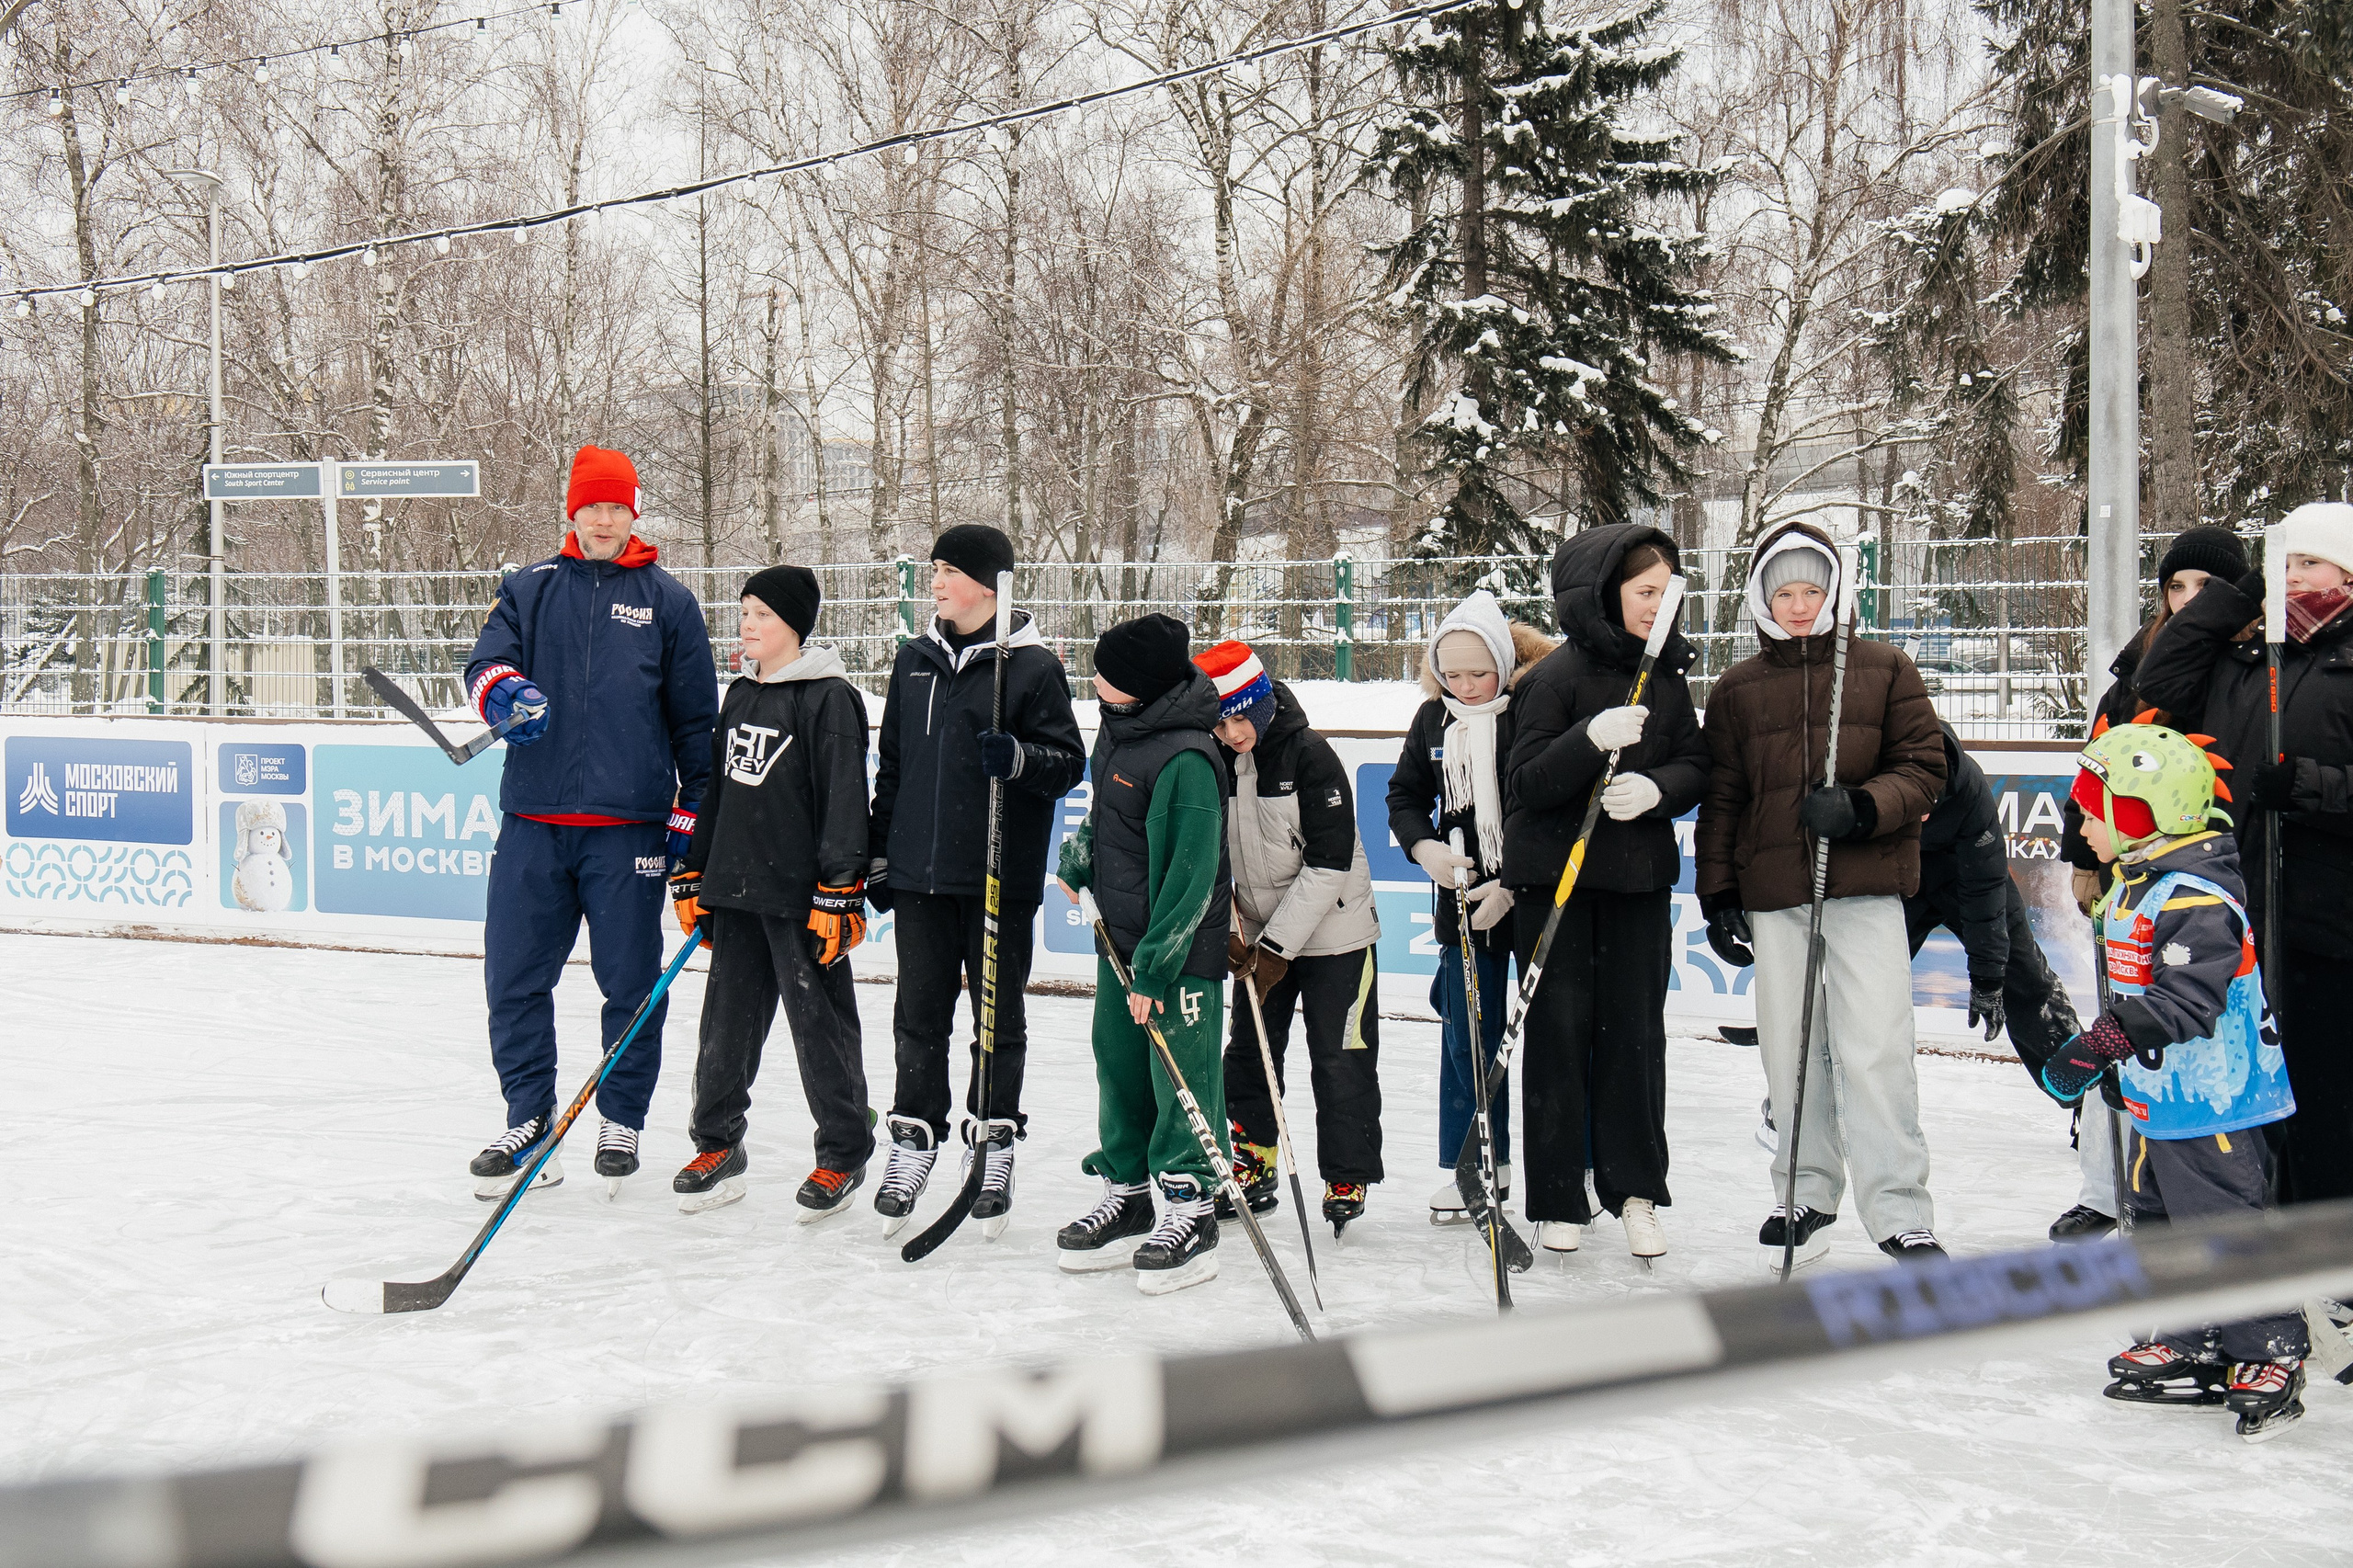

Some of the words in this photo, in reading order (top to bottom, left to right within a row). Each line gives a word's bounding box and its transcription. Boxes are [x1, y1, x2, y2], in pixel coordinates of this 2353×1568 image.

[224, 471, 254, 479] Южный
[254, 471, 300, 479] спортцентр
[244, 480, 262, 488] Sport
[360, 469, 411, 478] Сервисный
[413, 469, 440, 477] центр
[389, 478, 410, 486] point
[611, 603, 653, 620] РОССИЯ
[64, 761, 178, 793] МОСКОВСКИЙ
[64, 790, 119, 819] СПОРТ
[332, 789, 501, 842] ЗИМА
[333, 844, 354, 869] В
[1463, 959, 1472, 993] TACKS
[983, 935, 999, 1053] BAUER
[1497, 961, 1543, 1069] CCM
[1176, 1087, 1246, 1202] BAUER
[1478, 1109, 1496, 1207] CCM
[1164, 1180, 1190, 1190] BAUER
[290, 1353, 1165, 1568] CCM
